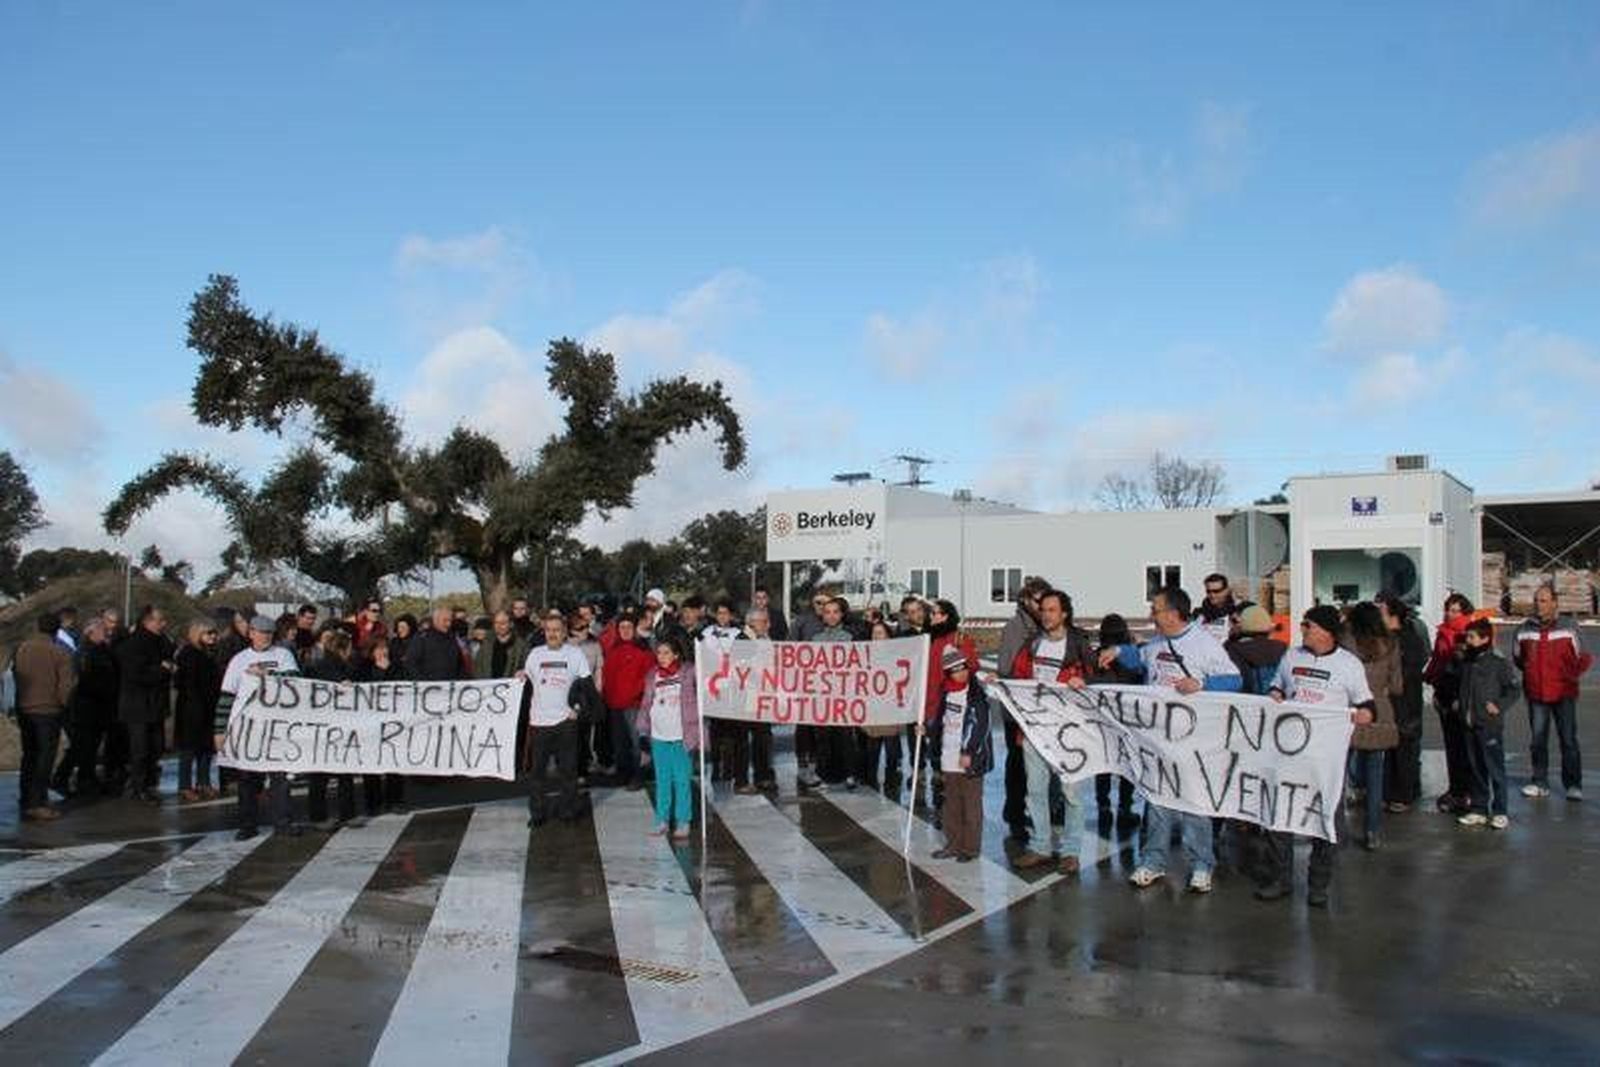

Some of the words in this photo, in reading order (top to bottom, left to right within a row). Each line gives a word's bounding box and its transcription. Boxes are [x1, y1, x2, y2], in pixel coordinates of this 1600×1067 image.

[797, 509, 876, 530] Berkeley
[774, 643, 872, 671] ¡BOADA!
[310, 681, 511, 717] BENEFICIOS
[756, 695, 867, 724] FUTURO
[222, 714, 364, 767] NUESTRA
[377, 718, 503, 772] RUINA
[1225, 704, 1312, 756] NO
[1193, 750, 1330, 834] VENTA
